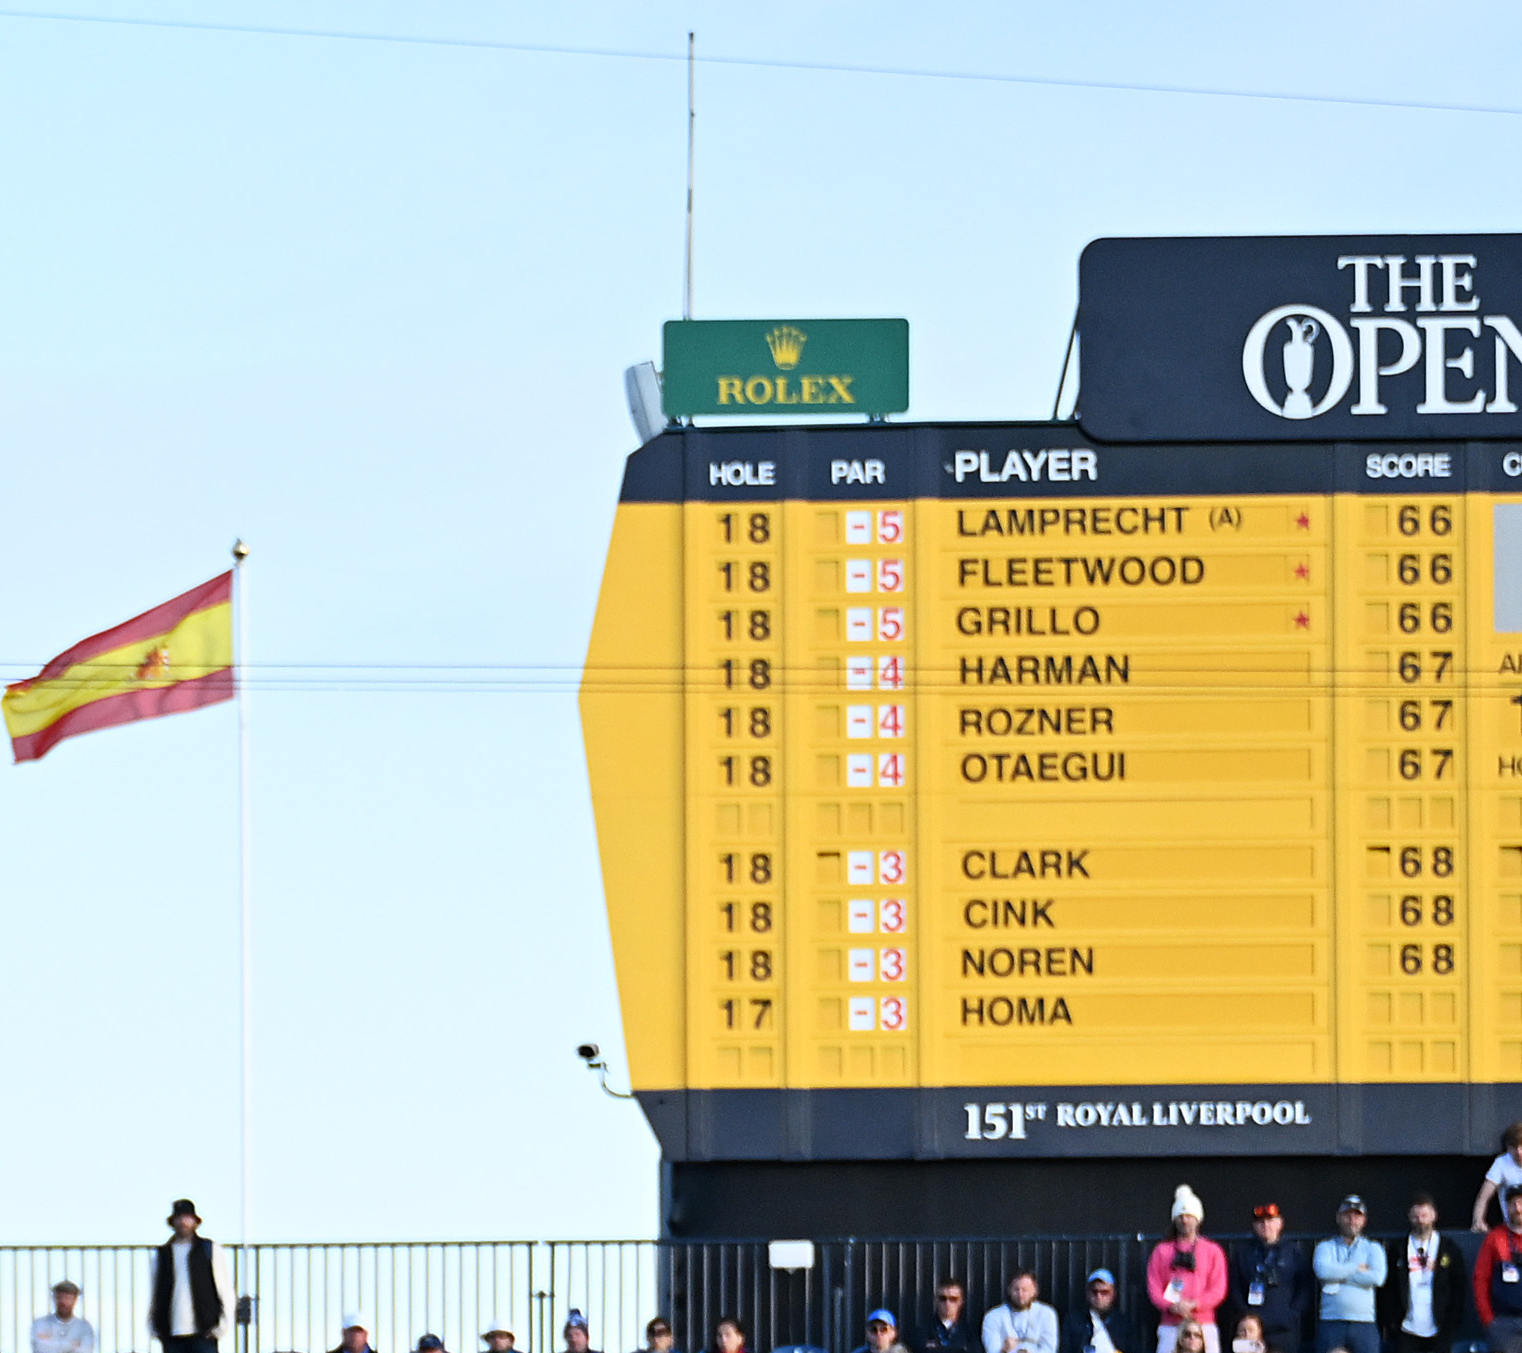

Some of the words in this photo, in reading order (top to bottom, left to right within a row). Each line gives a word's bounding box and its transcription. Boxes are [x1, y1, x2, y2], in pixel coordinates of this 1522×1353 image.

[1337, 253, 1481, 313] THE
[716, 374, 856, 405] ROLEX
[709, 461, 776, 486] HOLE
[831, 459, 886, 485] PAR
[955, 449, 1098, 483] PLAYER
[1366, 453, 1452, 478] SCORE
[718, 512, 771, 544] 18
[957, 506, 1189, 537] LAMPRECHT
[1208, 506, 1242, 532] (A)
[1398, 505, 1453, 537] 66
[718, 561, 771, 593] 18
[958, 555, 1205, 587] FLEETWOOD
[1398, 554, 1453, 585] 66
[718, 610, 771, 641] 18
[957, 606, 1101, 636] GRILLO
[1398, 603, 1453, 633] 66
[718, 659, 771, 690] 18
[959, 654, 1130, 685] HARMAN
[1398, 651, 1453, 682] 67
[718, 708, 771, 738] 18
[960, 708, 1114, 736] ROZNER
[1398, 700, 1453, 731] 67
[718, 756, 771, 787] 18
[961, 752, 1125, 783] OTAEGUI
[1398, 749, 1453, 780] 67
[719, 852, 772, 885] 18
[961, 849, 1091, 880] CLARK
[1400, 846, 1454, 878] 68
[719, 902, 772, 933] 18
[963, 899, 1056, 929] CINK
[1400, 895, 1454, 926] 68
[719, 950, 772, 982] 18
[961, 946, 1095, 977] NOREN
[1400, 944, 1454, 975] 68
[719, 999, 772, 1031] 17
[961, 997, 1073, 1026] HOMA
[1056, 1104, 1146, 1127] ROYAL
[1153, 1101, 1312, 1125] LIVERPOOL
